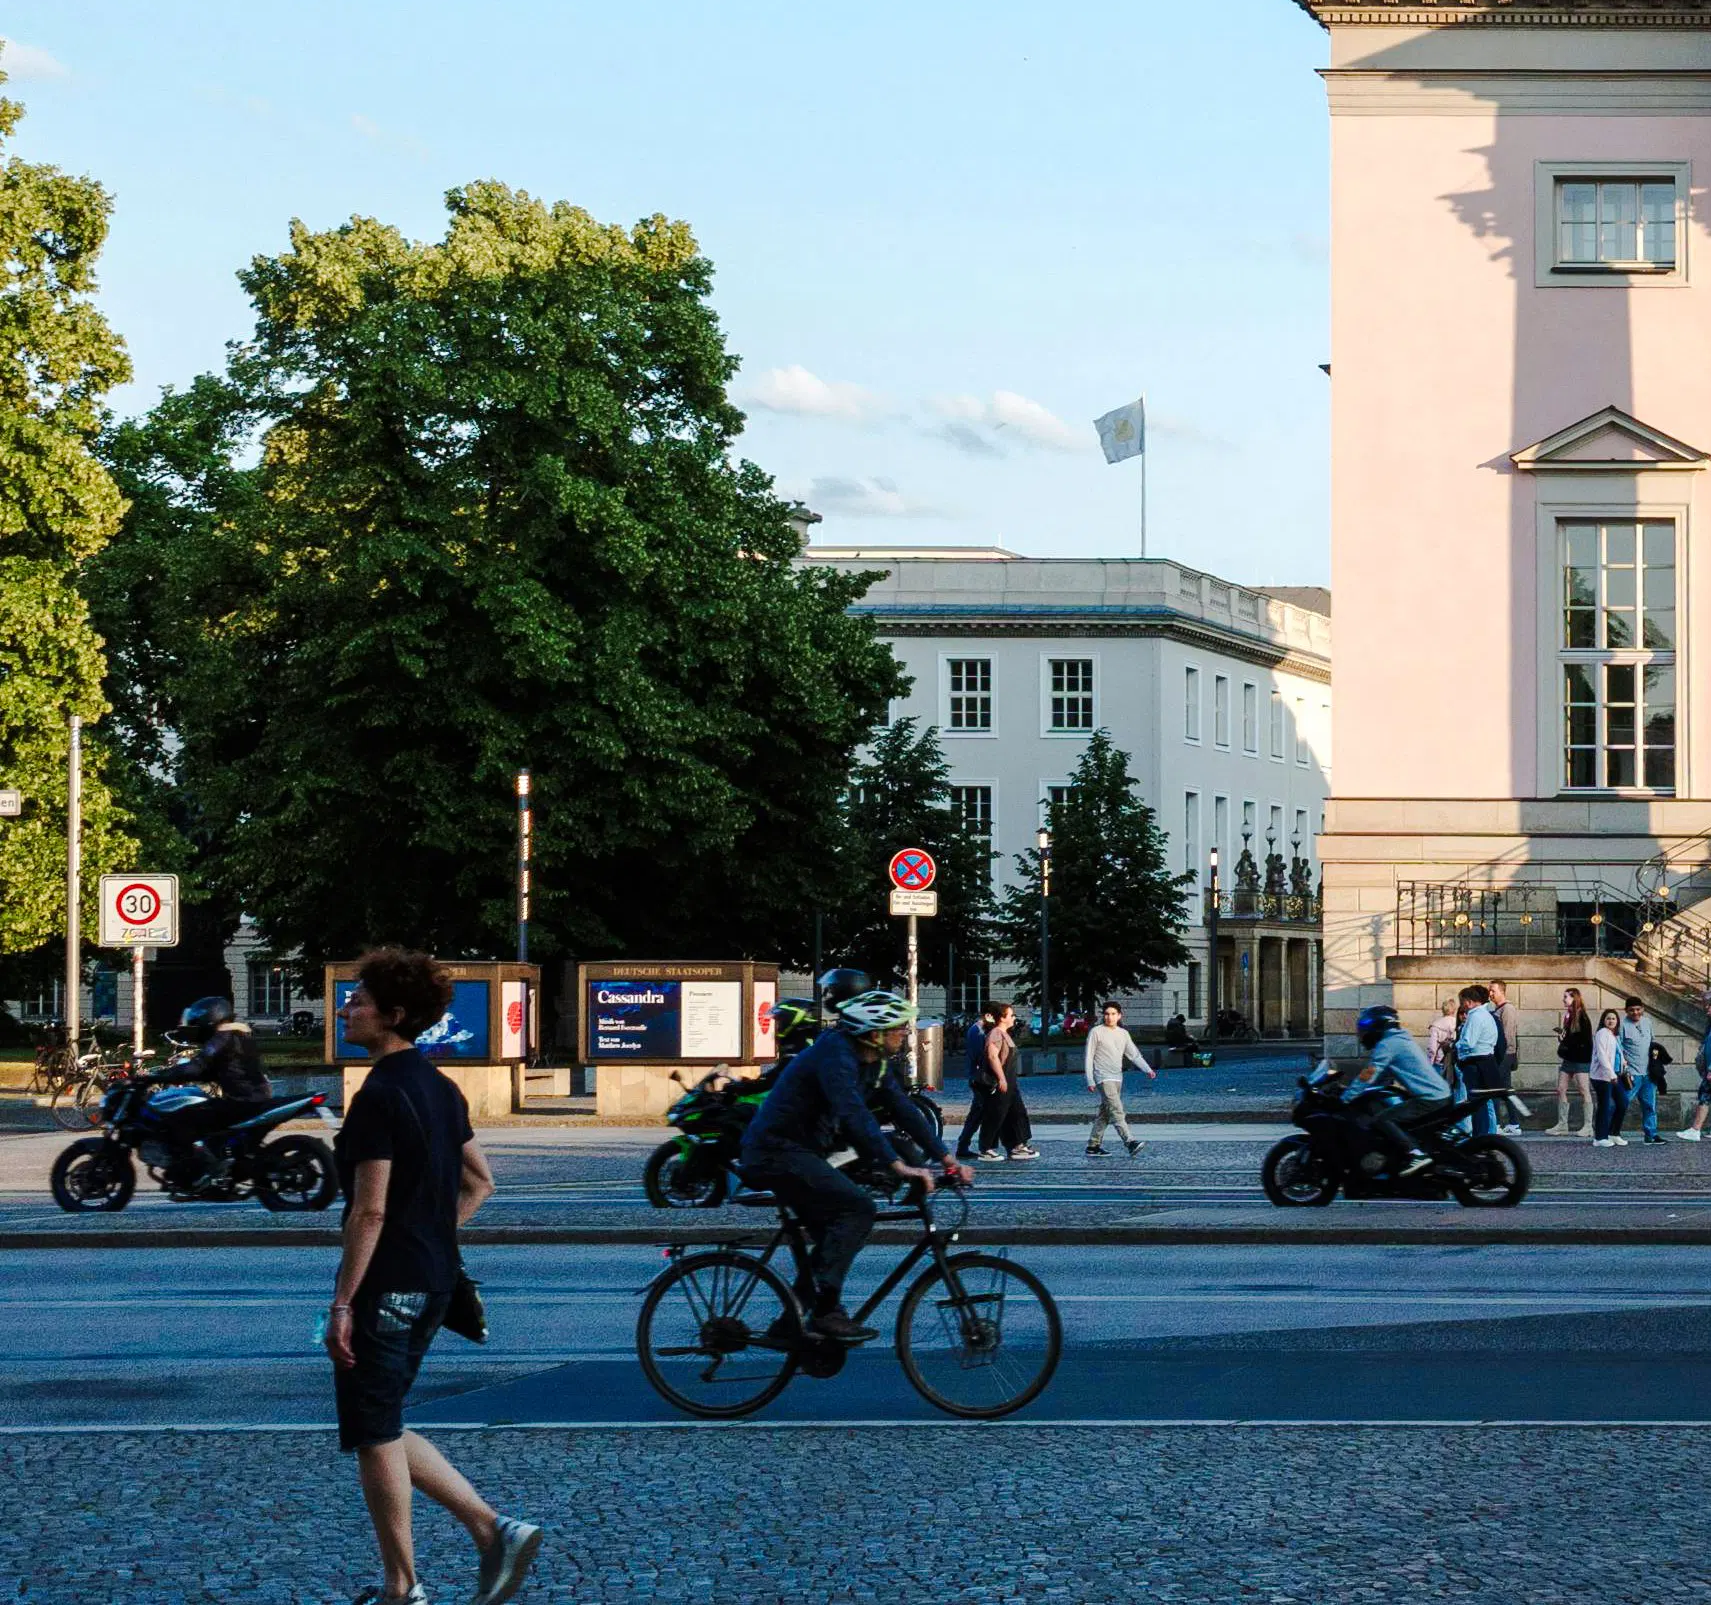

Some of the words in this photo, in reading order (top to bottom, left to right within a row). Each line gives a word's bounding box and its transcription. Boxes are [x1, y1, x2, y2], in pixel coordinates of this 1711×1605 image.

[125, 895, 152, 914] 30
[613, 967, 661, 976] DEUTSCHE
[666, 967, 722, 976] STAATSOPER
[597, 990, 665, 1004] Cassandra
